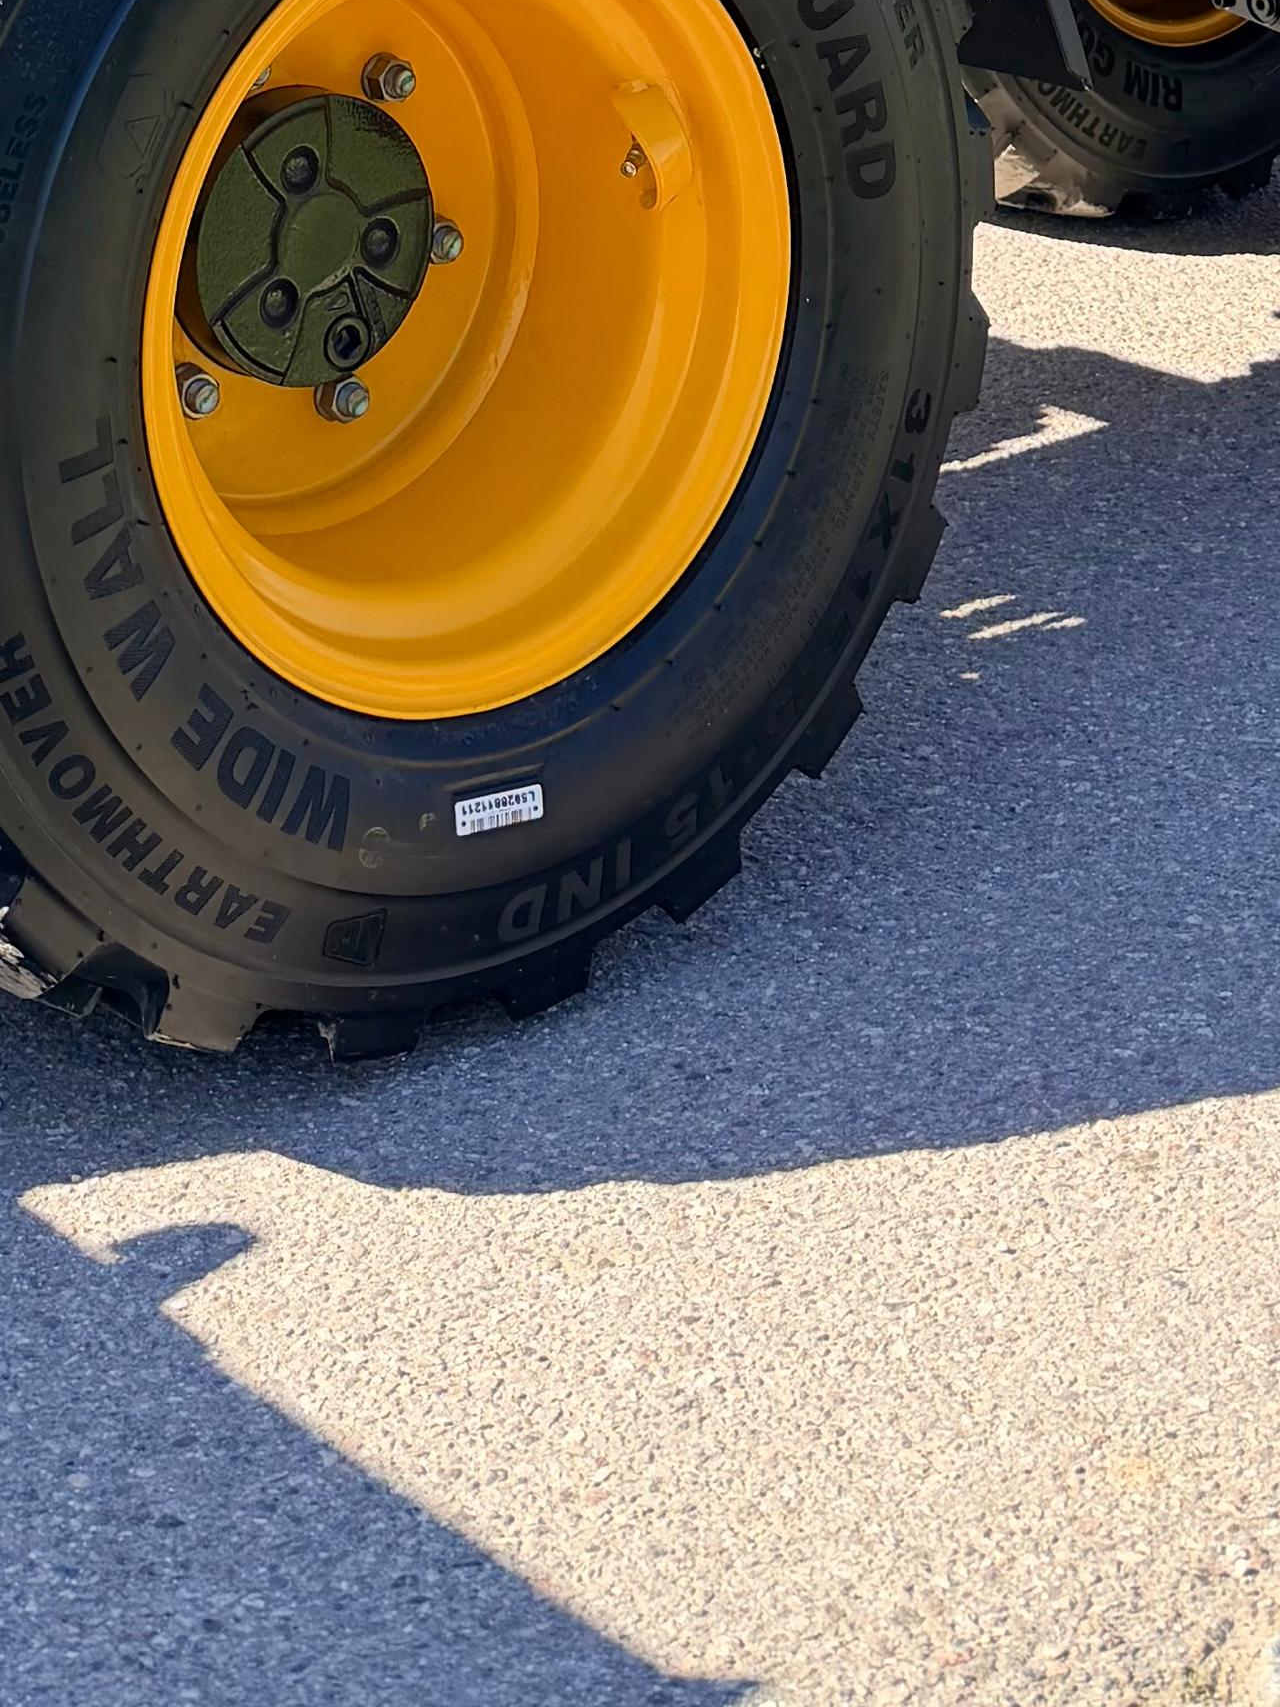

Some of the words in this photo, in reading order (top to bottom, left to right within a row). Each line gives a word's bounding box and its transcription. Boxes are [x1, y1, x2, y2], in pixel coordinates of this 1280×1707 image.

[1124, 57, 1184, 113] RIM
[58, 413, 177, 702] WALL
[169, 682, 351, 853] WIDE
[497, 840, 633, 945] IND
